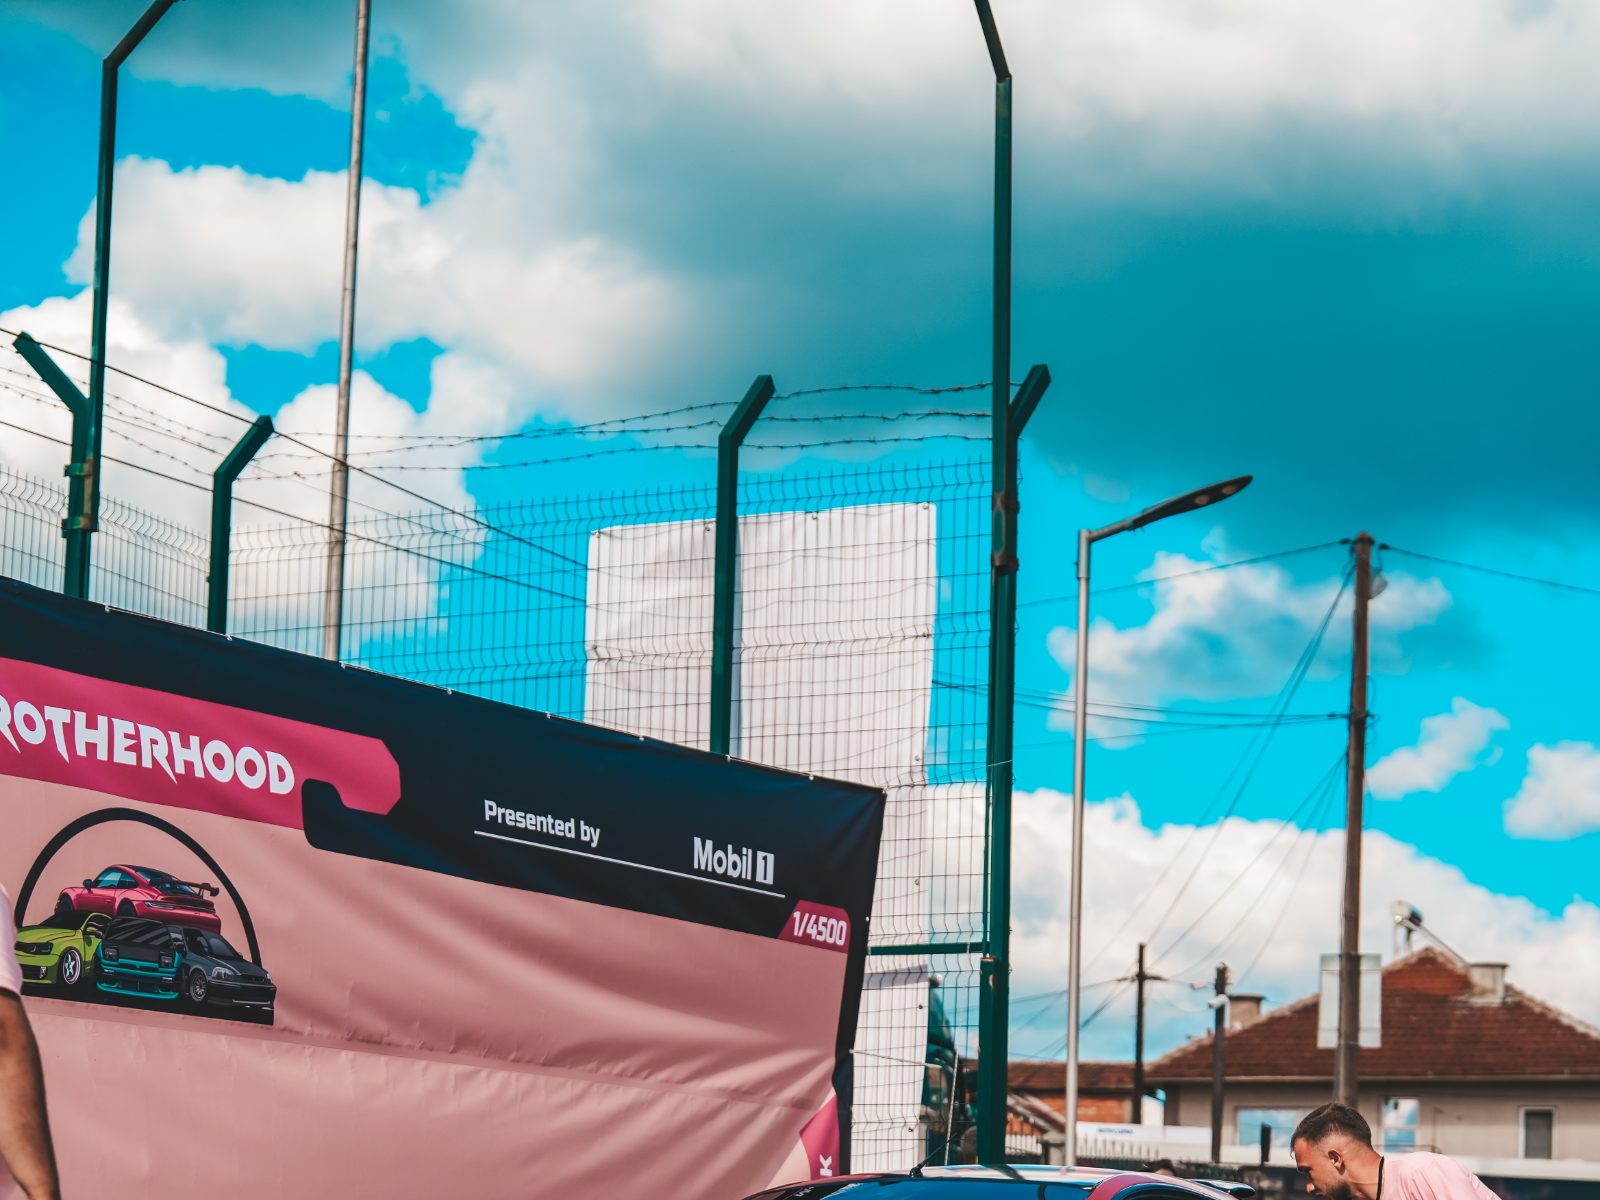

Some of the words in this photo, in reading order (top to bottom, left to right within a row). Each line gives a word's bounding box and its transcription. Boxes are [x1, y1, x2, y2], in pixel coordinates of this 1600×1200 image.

[484, 799, 576, 839] Presented
[579, 819, 601, 848] by
[693, 836, 753, 881] Mobil
[793, 910, 848, 946] 1/4500
